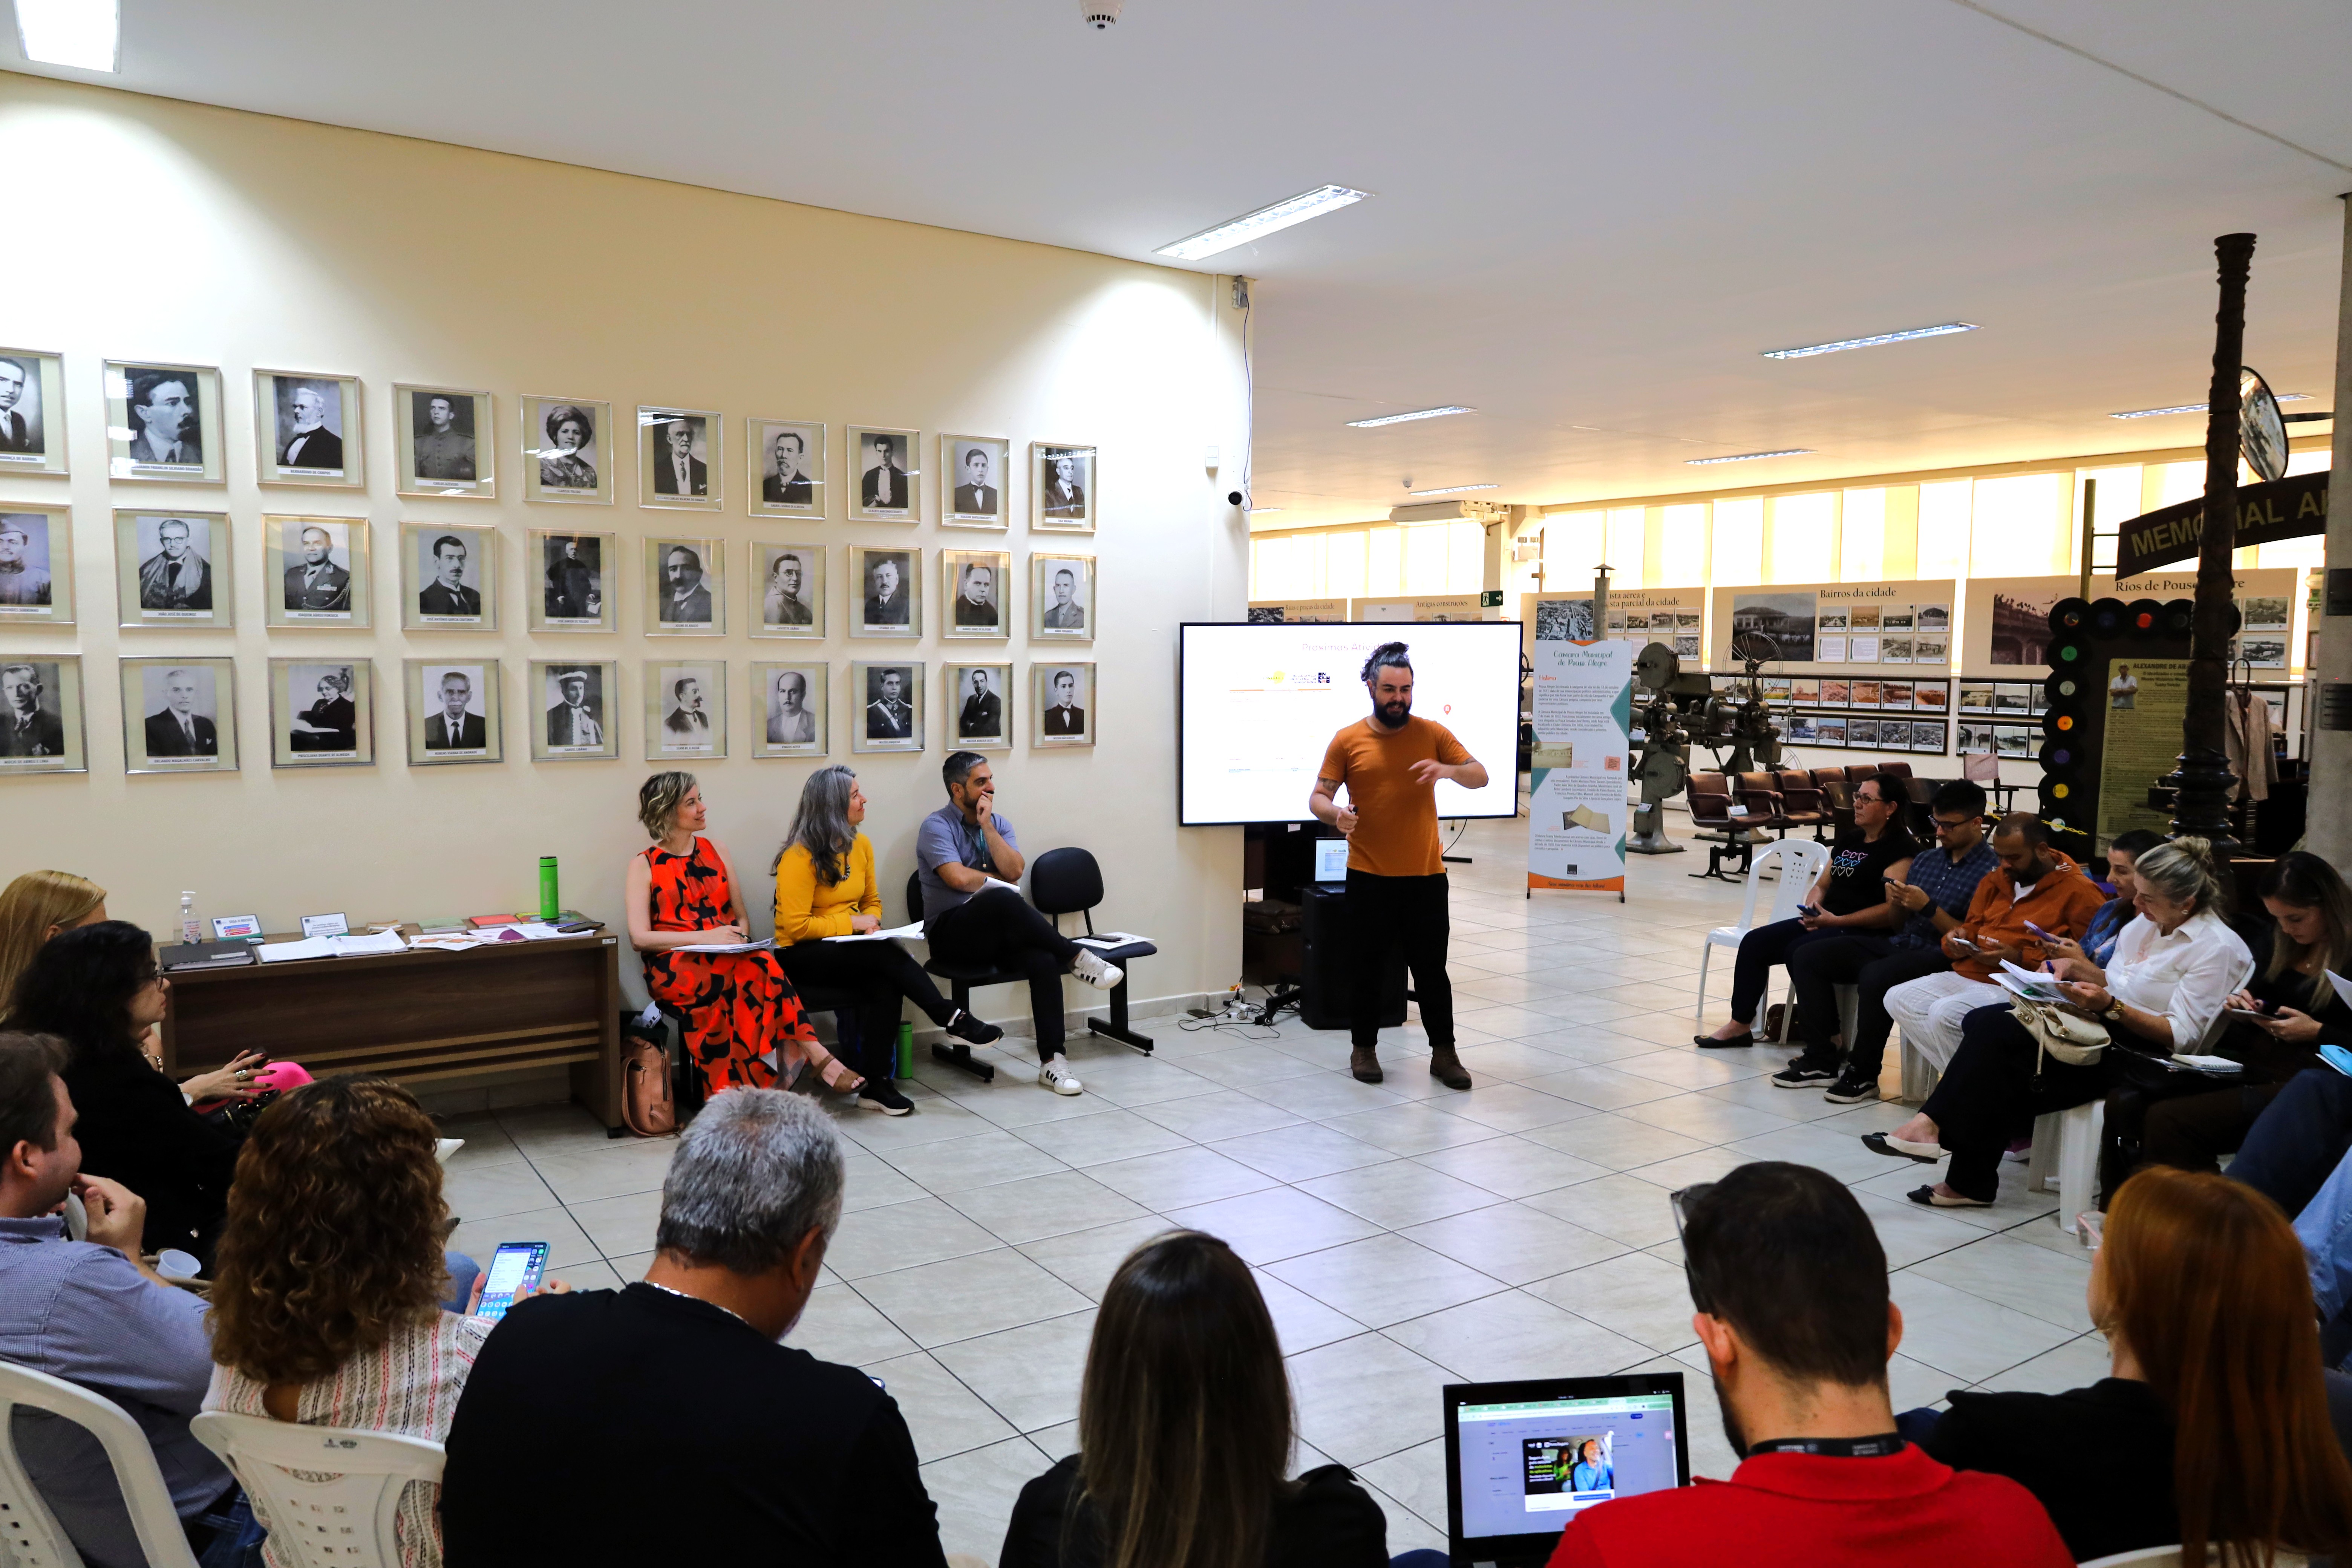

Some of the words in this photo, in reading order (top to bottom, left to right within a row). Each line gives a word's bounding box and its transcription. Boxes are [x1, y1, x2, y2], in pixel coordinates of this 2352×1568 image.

[2131, 498, 2284, 557] MEMIAL
[2116, 582, 2141, 591] Rios
[2145, 580, 2159, 591] de
[1820, 590, 1850, 598] Bairros
[1853, 588, 1864, 597] da
[1866, 587, 1896, 597] cidade
[1622, 599, 1644, 609] parcial
[1657, 597, 1680, 606] cidade
[1582, 650, 1613, 660] Municipal
[1588, 659, 1607, 668] Alegre
